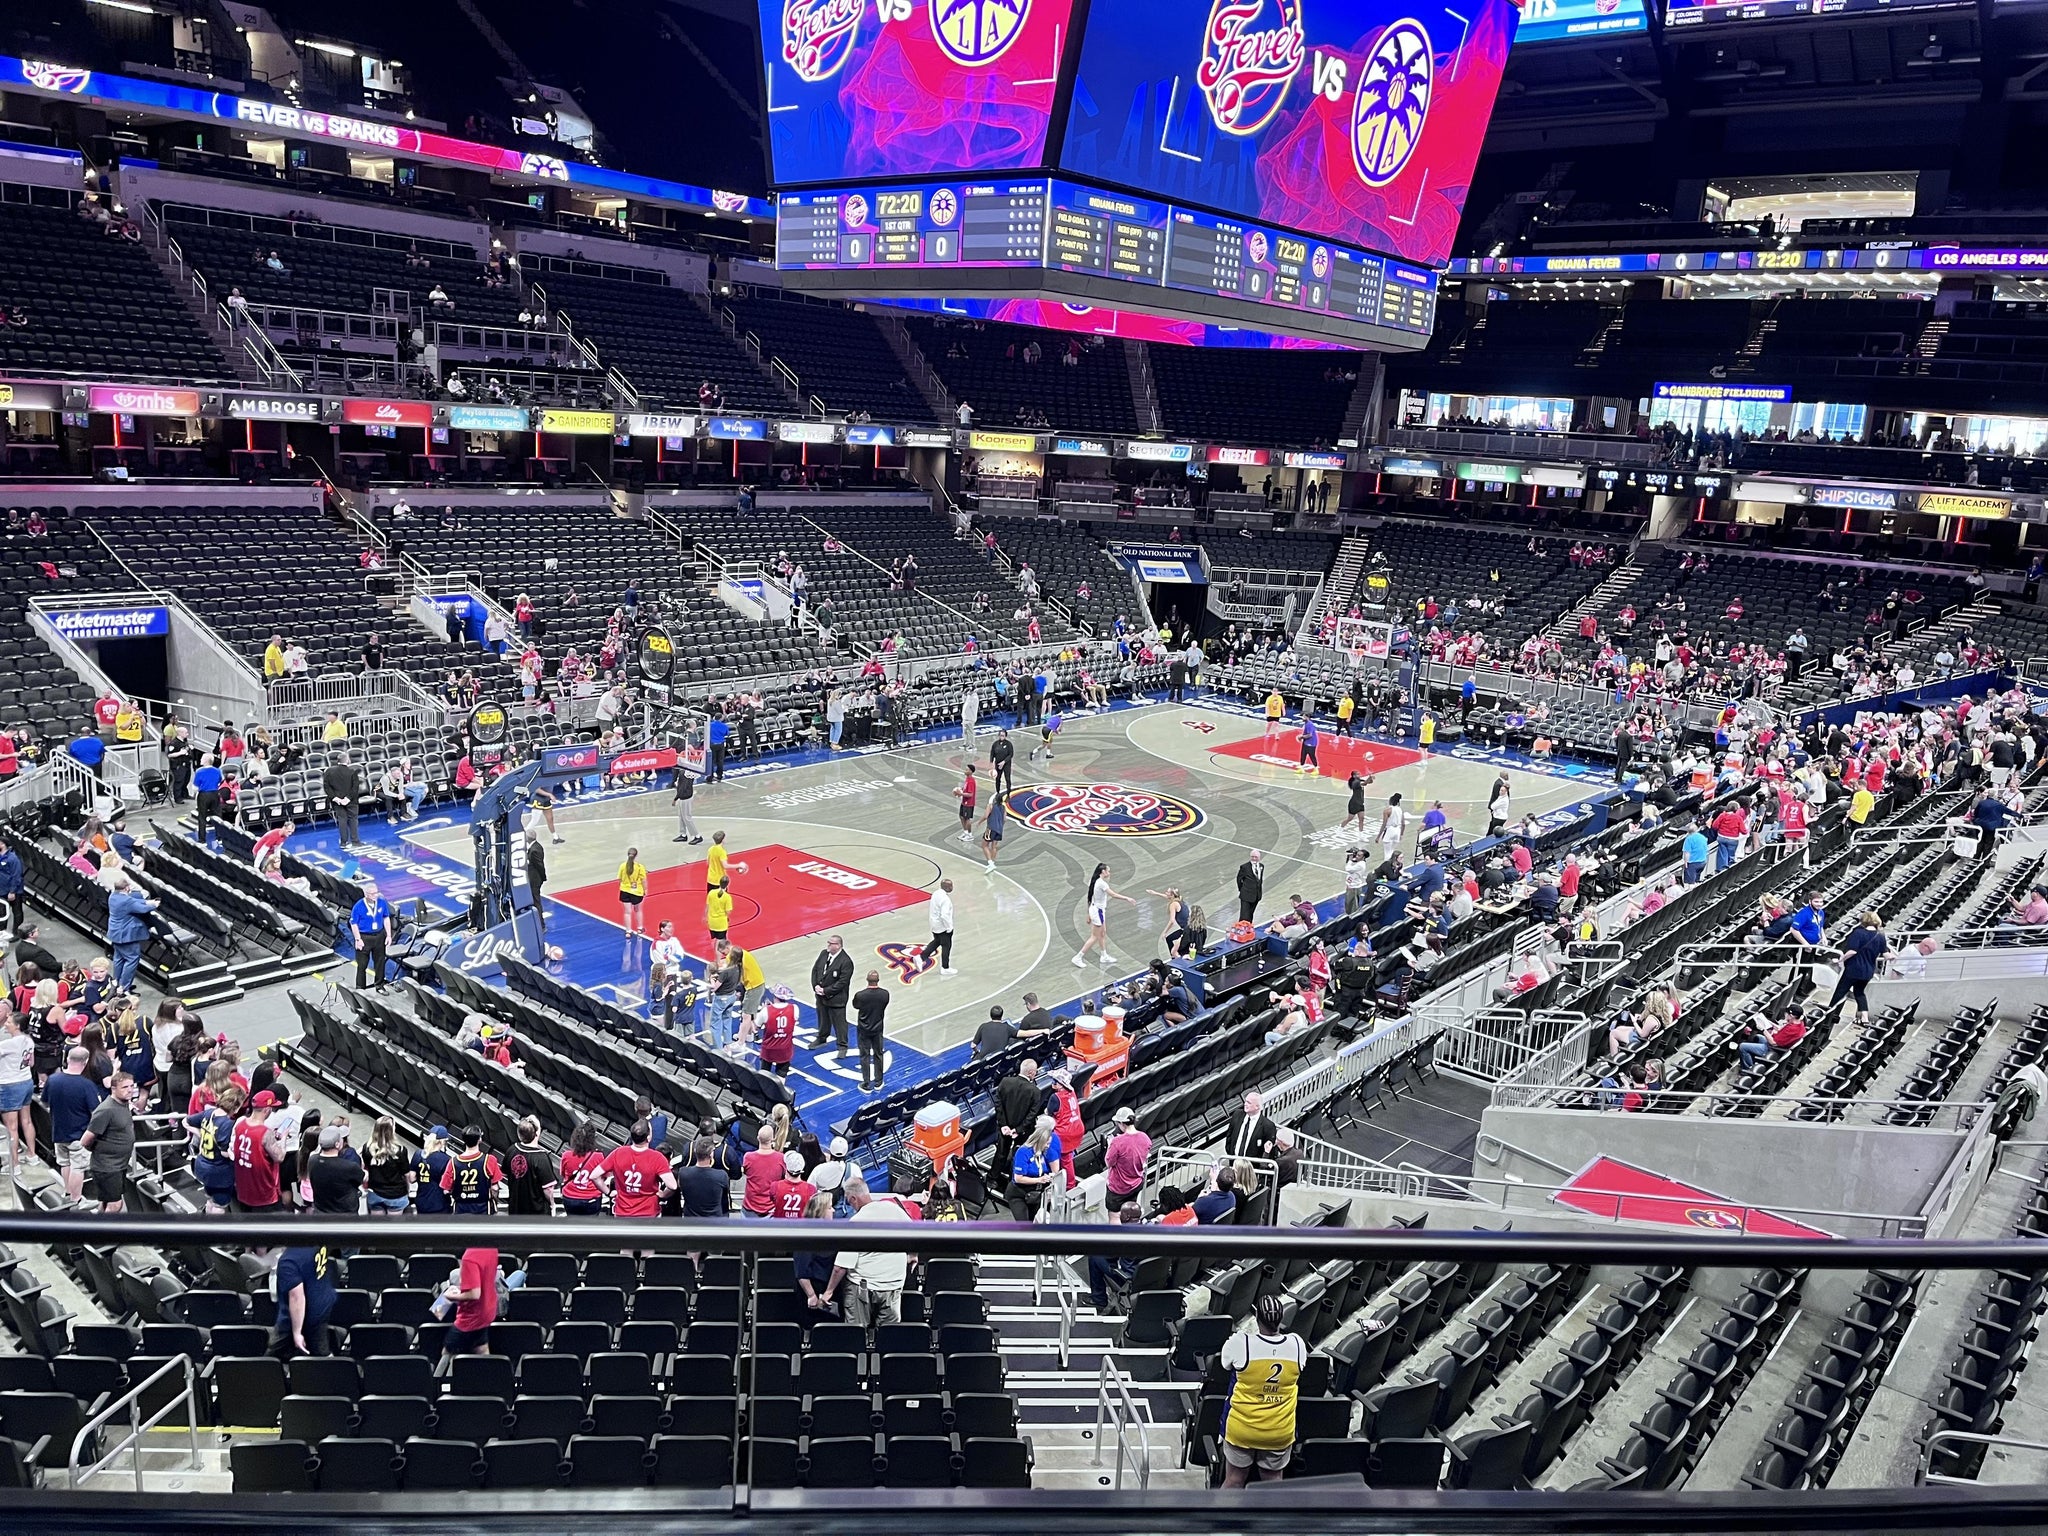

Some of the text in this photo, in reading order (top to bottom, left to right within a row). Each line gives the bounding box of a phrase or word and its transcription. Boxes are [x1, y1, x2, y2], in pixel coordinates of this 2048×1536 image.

[243, 13, 257, 25] 225
[783, 0, 865, 62] Fever
[876, 0, 913, 23] VS
[1197, 3, 1305, 91] Fever
[1311, 50, 1347, 102] VS
[238, 101, 300, 129] FEVER
[327, 116, 399, 148] SPARKS
[877, 194, 920, 215] 72:20
[1089, 197, 1135, 216] INDIANA FEVER
[884, 221, 896, 231] 1ST
[850, 239, 860, 258] 0
[935, 236, 947, 256] 0
[1277, 239, 1305, 262] 72:20
[1547, 257, 1621, 270] INDIANA FEVER
[1675, 255, 1686, 269] 0
[1757, 252, 1802, 268] 72:20
[1875, 250, 1888, 267] 0
[1934, 253, 1959, 265] LOS
[1960, 253, 2018, 265] ANGELES
[1251, 273, 1261, 293] 0
[1312, 286, 1320, 304] 0
[137, 391, 176, 410] mhs
[1669, 385, 1785, 399] GAINBRIDGE FIELDHOUSE
[228, 398, 318, 416] AMBROSE
[376, 404, 402, 422] Lilly
[558, 415, 612, 429] GAINBRIDGE
[643, 416, 682, 429] IBEW
[731, 421, 753, 437] Kroger
[975, 433, 1026, 446] Koorsen
[1304, 454, 1345, 467] KennMar
[1598, 470, 1619, 480] FEVER
[1694, 477, 1721, 487] SPARKS
[312, 493, 319, 502] 15
[1813, 489, 1896, 506] SHIPSIGMA
[1936, 497, 2008, 510] LIFT ACADEMY
[1123, 548, 1193, 559] OLD NATIONAL BANK
[55, 611, 155, 629] ticketmaster
[123, 626, 146, 635] CLUB
[128, 720, 140, 731] 22
[577, 785, 648, 800] Google
[759, 780, 895, 809] GAINBRIDGE
[760, 778, 865, 800] FIELDHOUSE
[1025, 784, 1161, 832] Fever
[510, 831, 527, 887] RCA
[461, 933, 525, 971] Lilly
[28, 1010, 42, 1028] 22
[776, 1015, 787, 1028] 10
[942, 1122, 952, 1138] G
[238, 1135, 252, 1155] 22
[460, 1168, 478, 1185] 22
[573, 1168, 589, 1185] 22
[624, 1170, 642, 1187] 22
[783, 1193, 802, 1211] 22
[315, 1245, 328, 1272] 22
[1266, 1363, 1283, 1384] 2
[1262, 1385, 1279, 1393] GRAY
